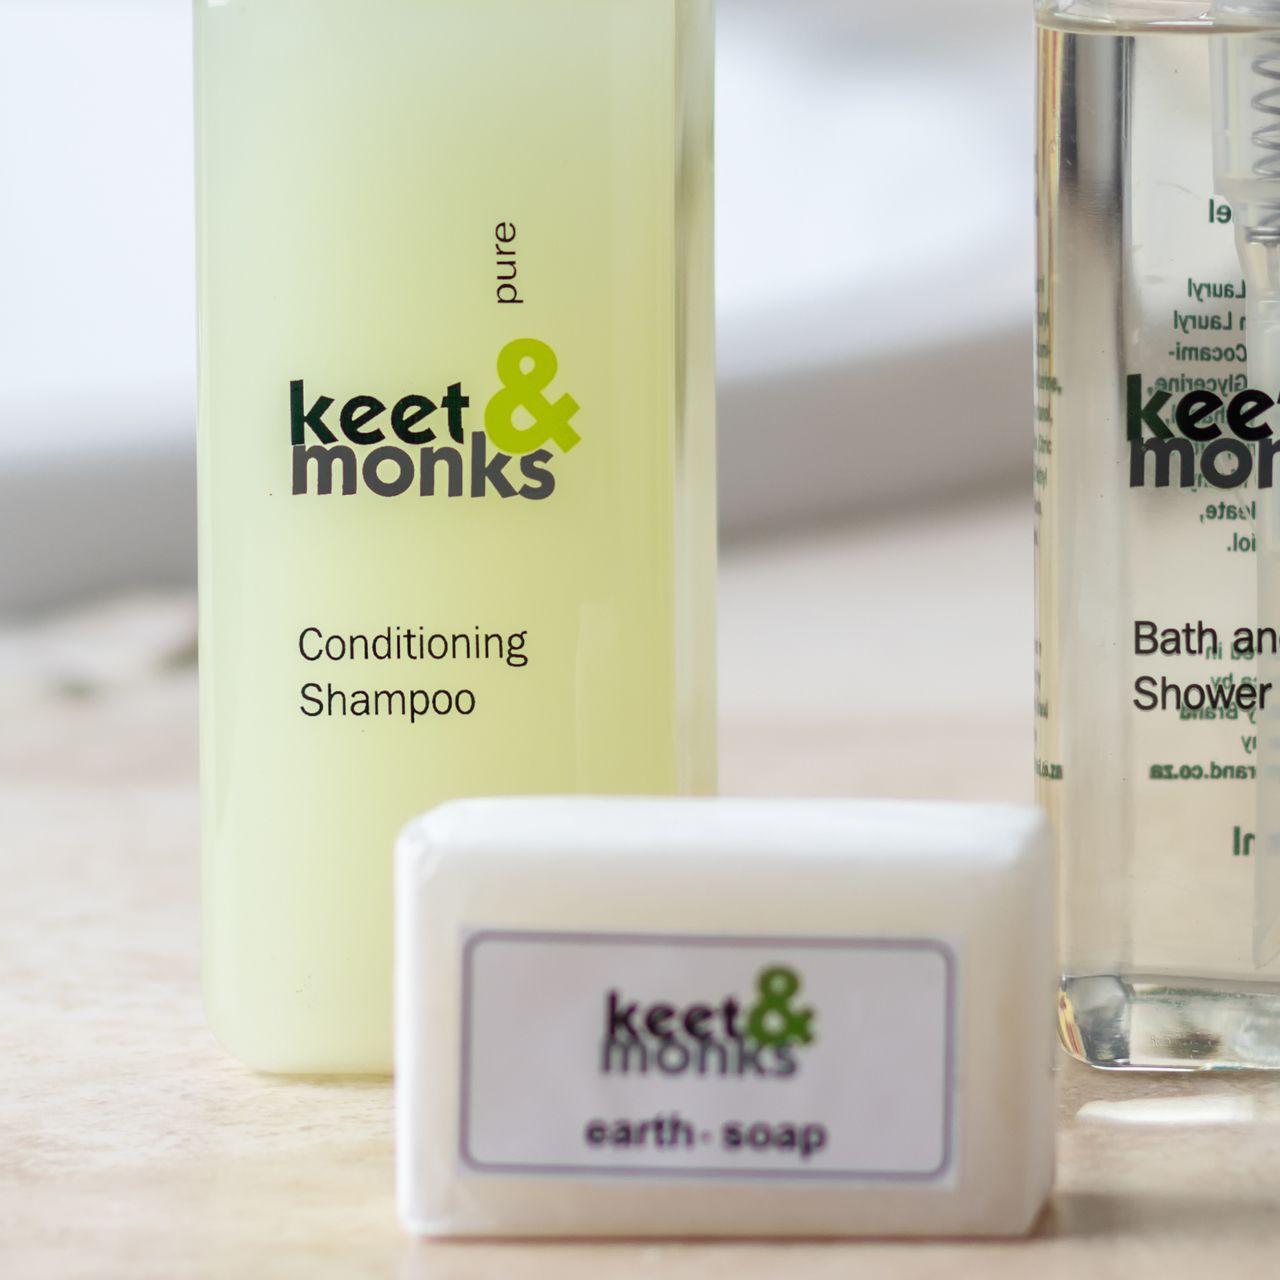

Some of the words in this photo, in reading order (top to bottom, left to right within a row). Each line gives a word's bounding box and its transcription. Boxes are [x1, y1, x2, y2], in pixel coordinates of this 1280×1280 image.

[495, 221, 524, 305] pure
[289, 379, 470, 445] keet
[291, 431, 556, 500] monks
[298, 626, 529, 667] Conditioning
[1132, 620, 1219, 656] Bath
[299, 683, 477, 723] Shampoo
[1132, 676, 1273, 711] Shower
[605, 988, 741, 1040] keet
[601, 1031, 799, 1078] monks
[722, 1121, 829, 1160] soap
